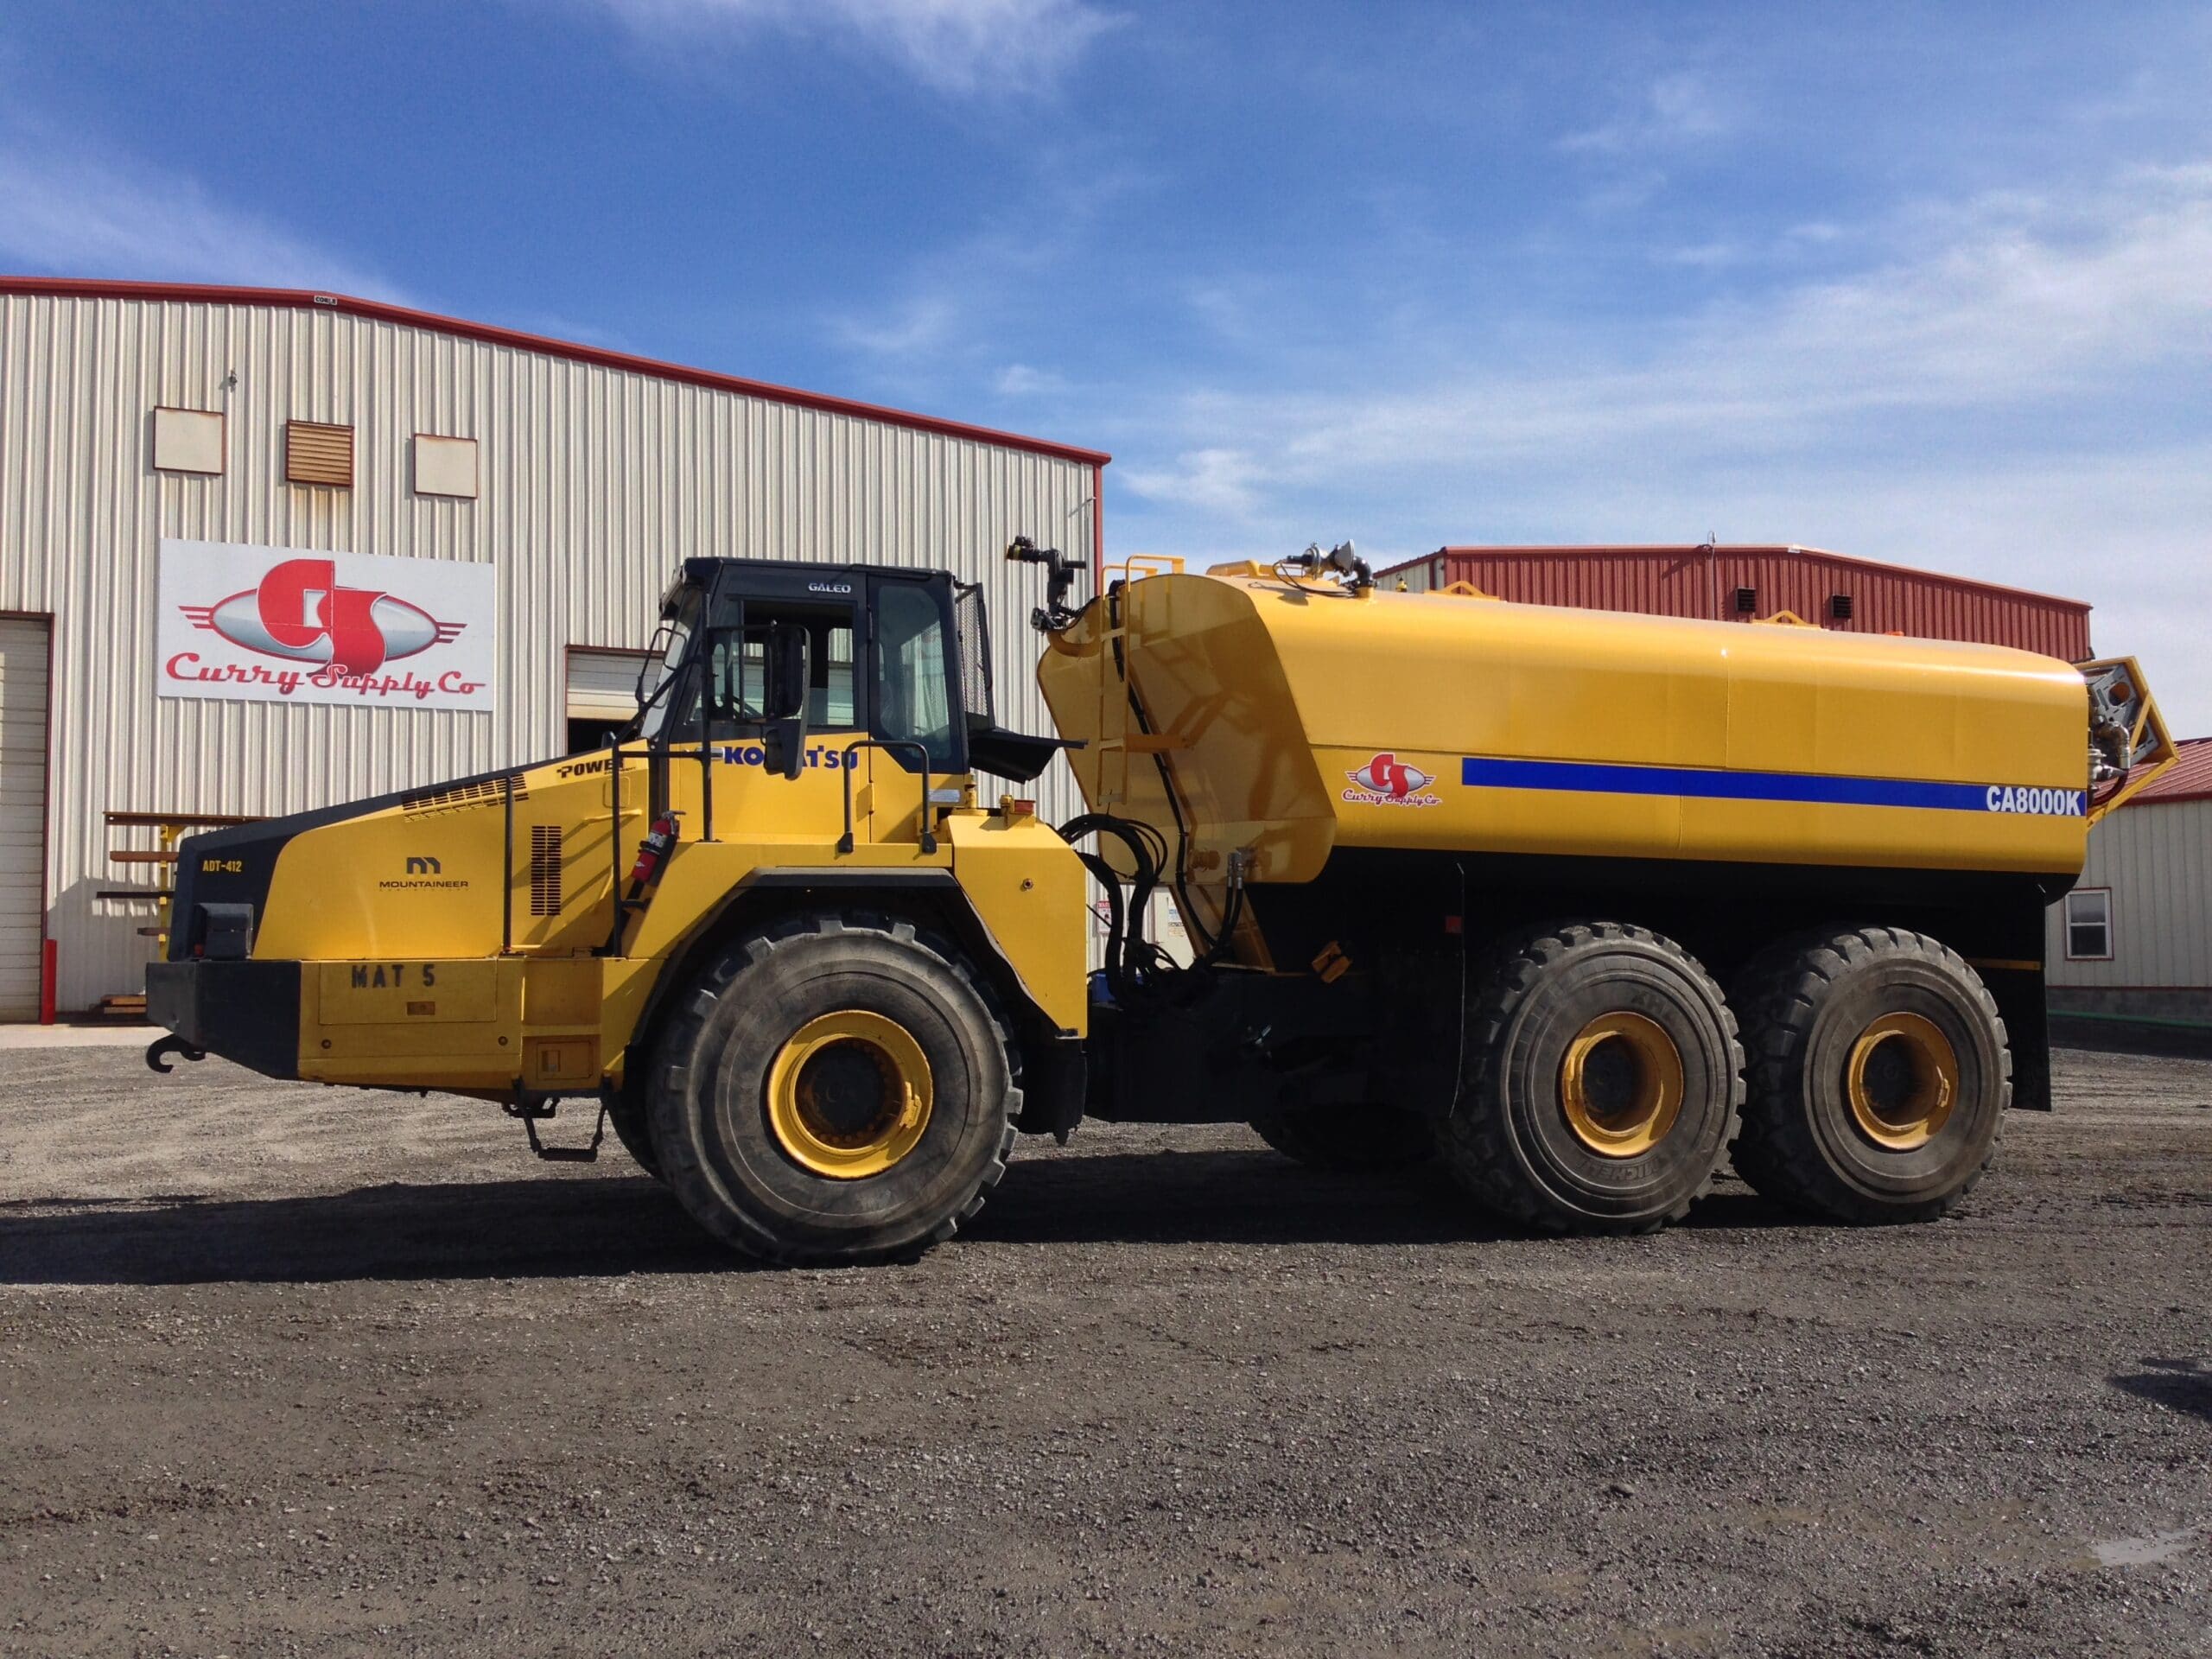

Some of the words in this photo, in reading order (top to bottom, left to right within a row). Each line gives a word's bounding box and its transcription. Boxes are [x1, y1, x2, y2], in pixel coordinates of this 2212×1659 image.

[808, 582, 852, 594] GALEO
[166, 652, 304, 695] Curry
[311, 664, 435, 699] Supply
[438, 671, 486, 695] Co
[724, 745, 858, 770] KOTSU
[1342, 789, 1382, 805] Curry
[1385, 792, 1424, 807] Supply
[1425, 795, 1440, 804] Co
[1986, 785, 2082, 817] CA8000K
[202, 860, 242, 872] ADT-412
[352, 963, 404, 988] MAT
[423, 963, 435, 988] 5
